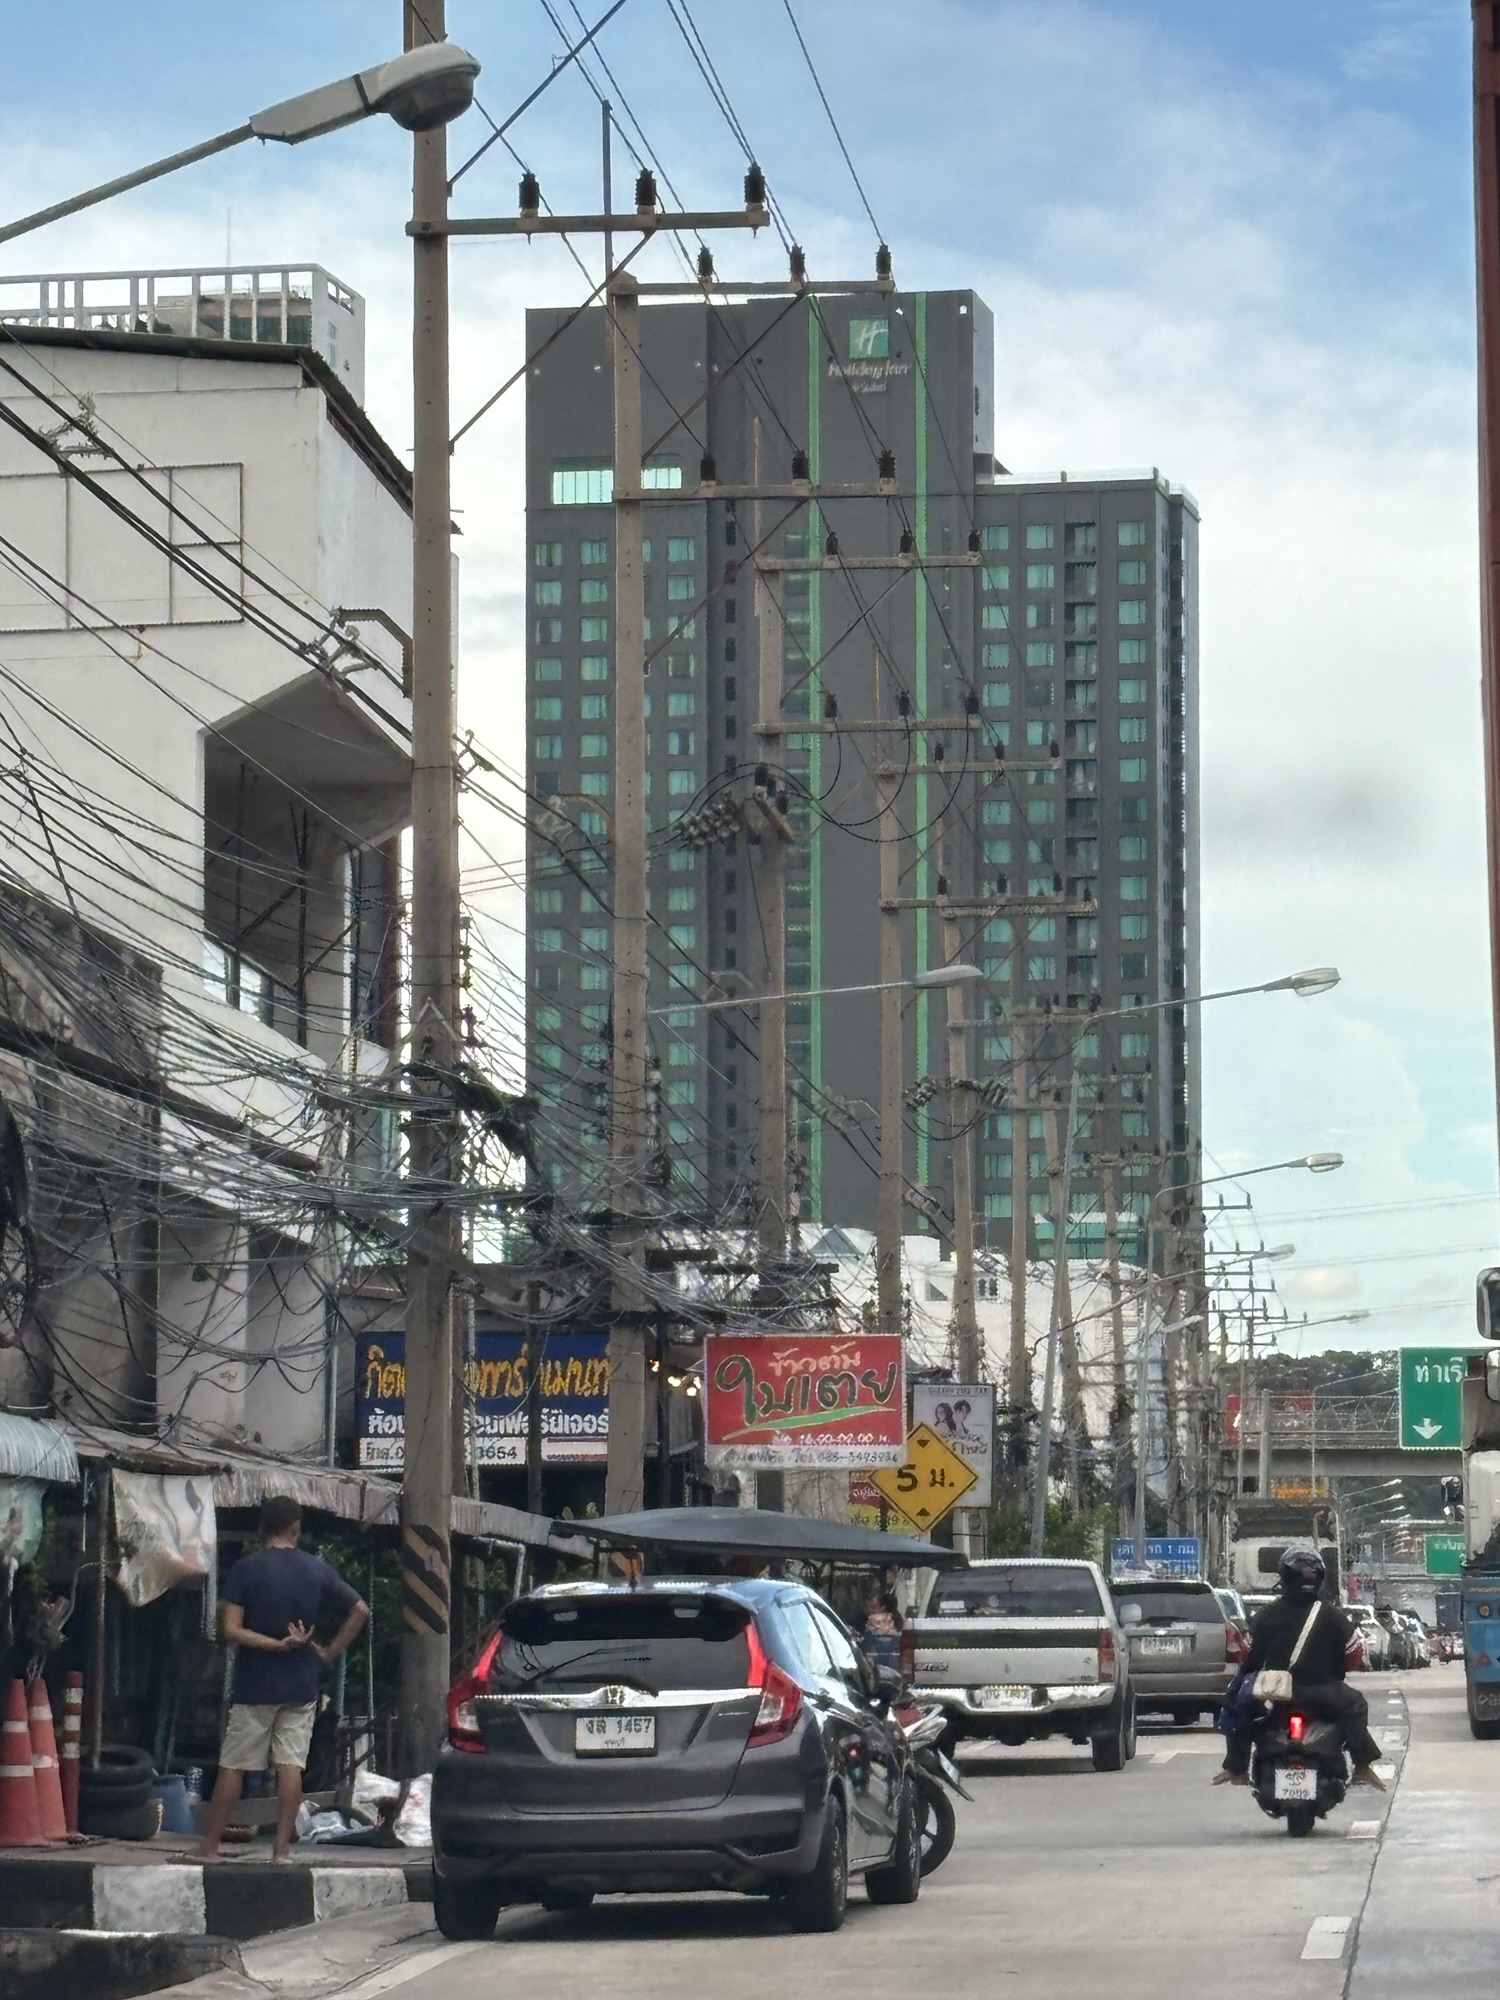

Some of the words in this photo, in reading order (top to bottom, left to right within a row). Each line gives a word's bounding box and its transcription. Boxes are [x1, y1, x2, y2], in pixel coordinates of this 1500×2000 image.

[768, 1341, 861, 1377] ข้าวต้ม
[714, 1354, 897, 1426] ใบเตย
[897, 1464, 918, 1492] 5
[929, 1468, 955, 1487] ม.
